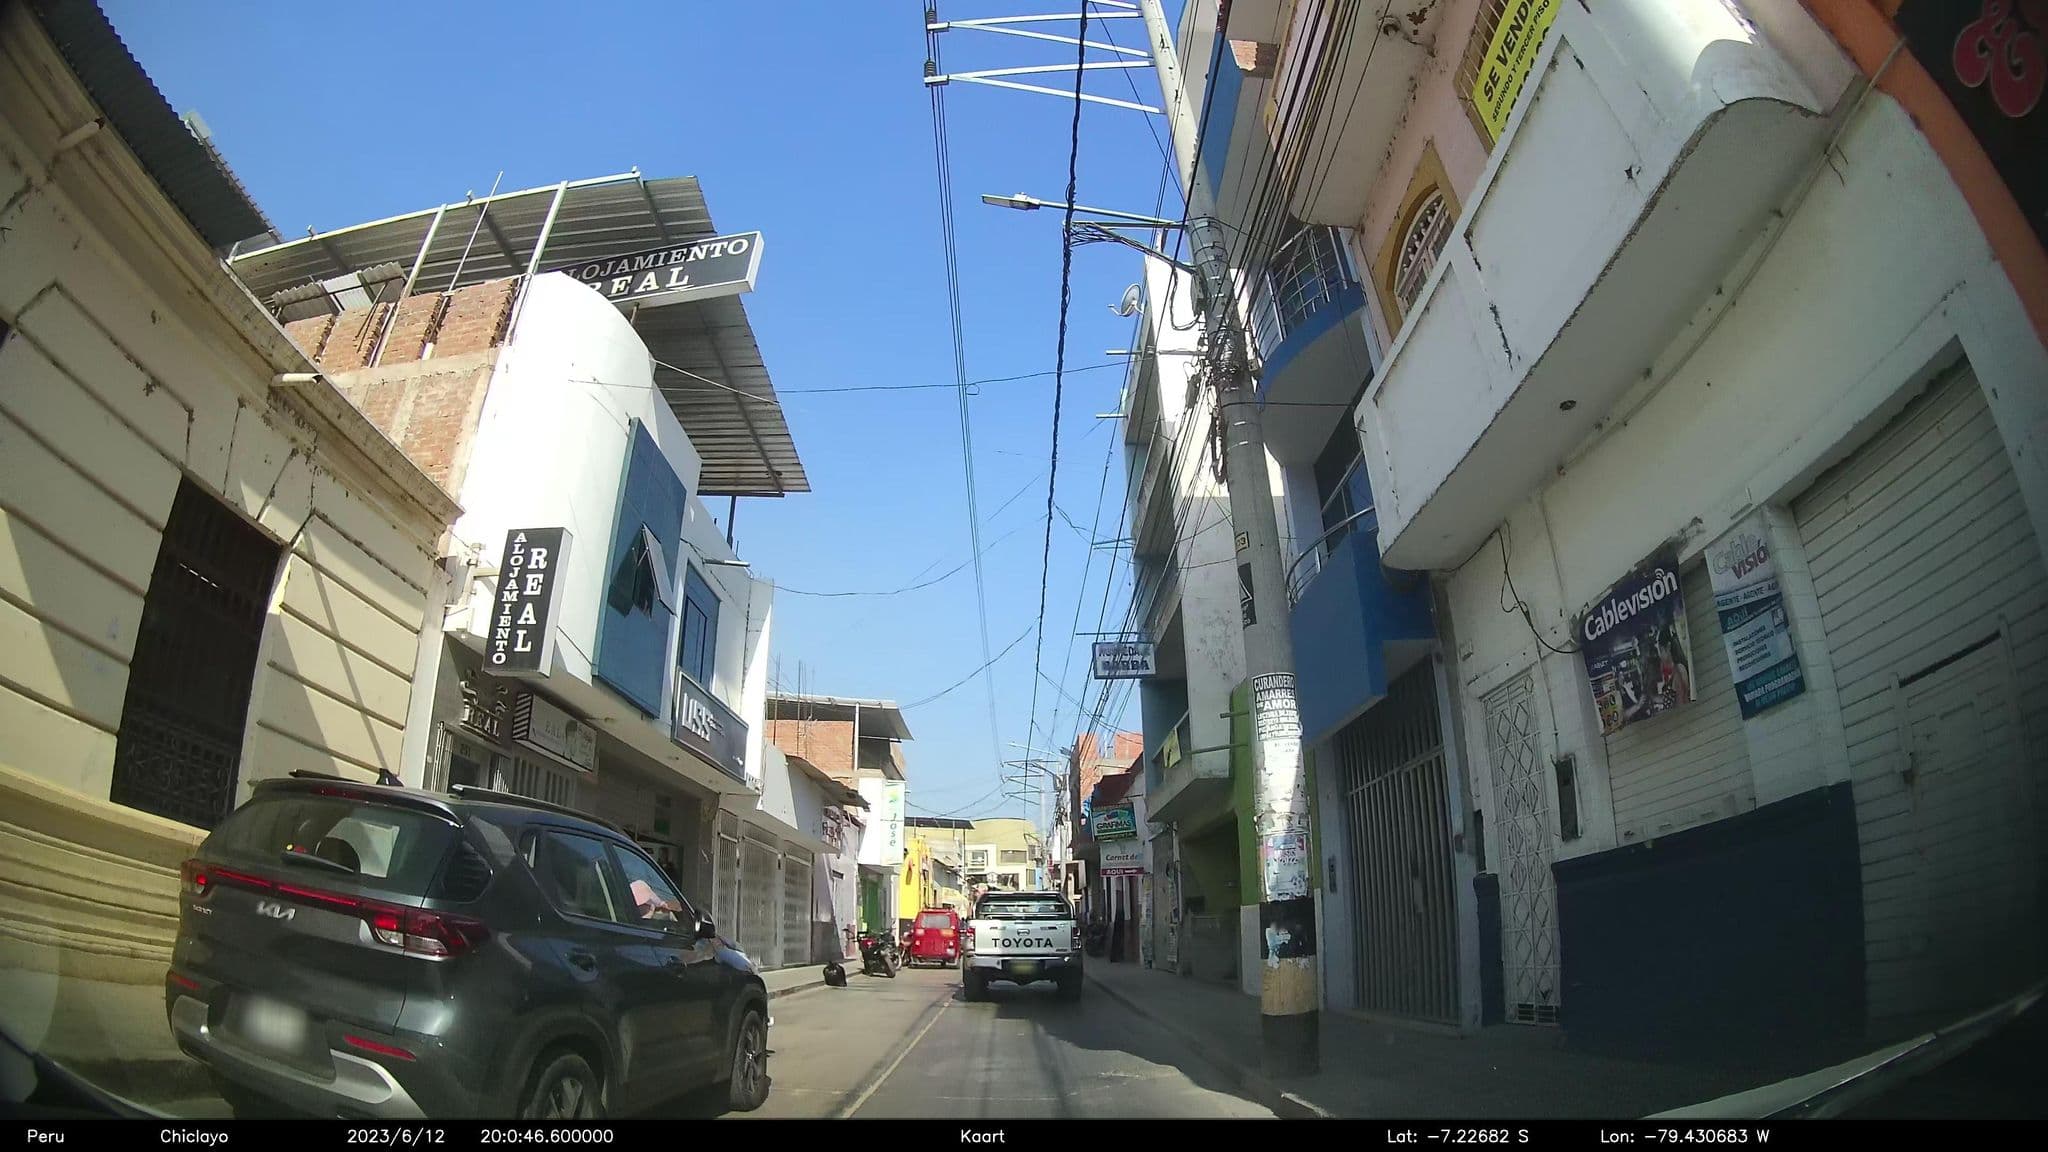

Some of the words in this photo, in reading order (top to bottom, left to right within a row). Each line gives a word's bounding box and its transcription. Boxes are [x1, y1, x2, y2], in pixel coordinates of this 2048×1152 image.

[1483, 65, 1501, 103] SE
[1492, 73, 1514, 122] SEGUNDO
[1516, 24, 1536, 65] TERCER
[1533, 0, 1550, 25] PISO
[492, 532, 527, 664] ALOJAMIENTO
[514, 547, 548, 652] REAL
[1584, 568, 1678, 641] Cablevisión
[1264, 698, 1297, 711] AMOR
[992, 938, 1053, 948] TOYOTA
